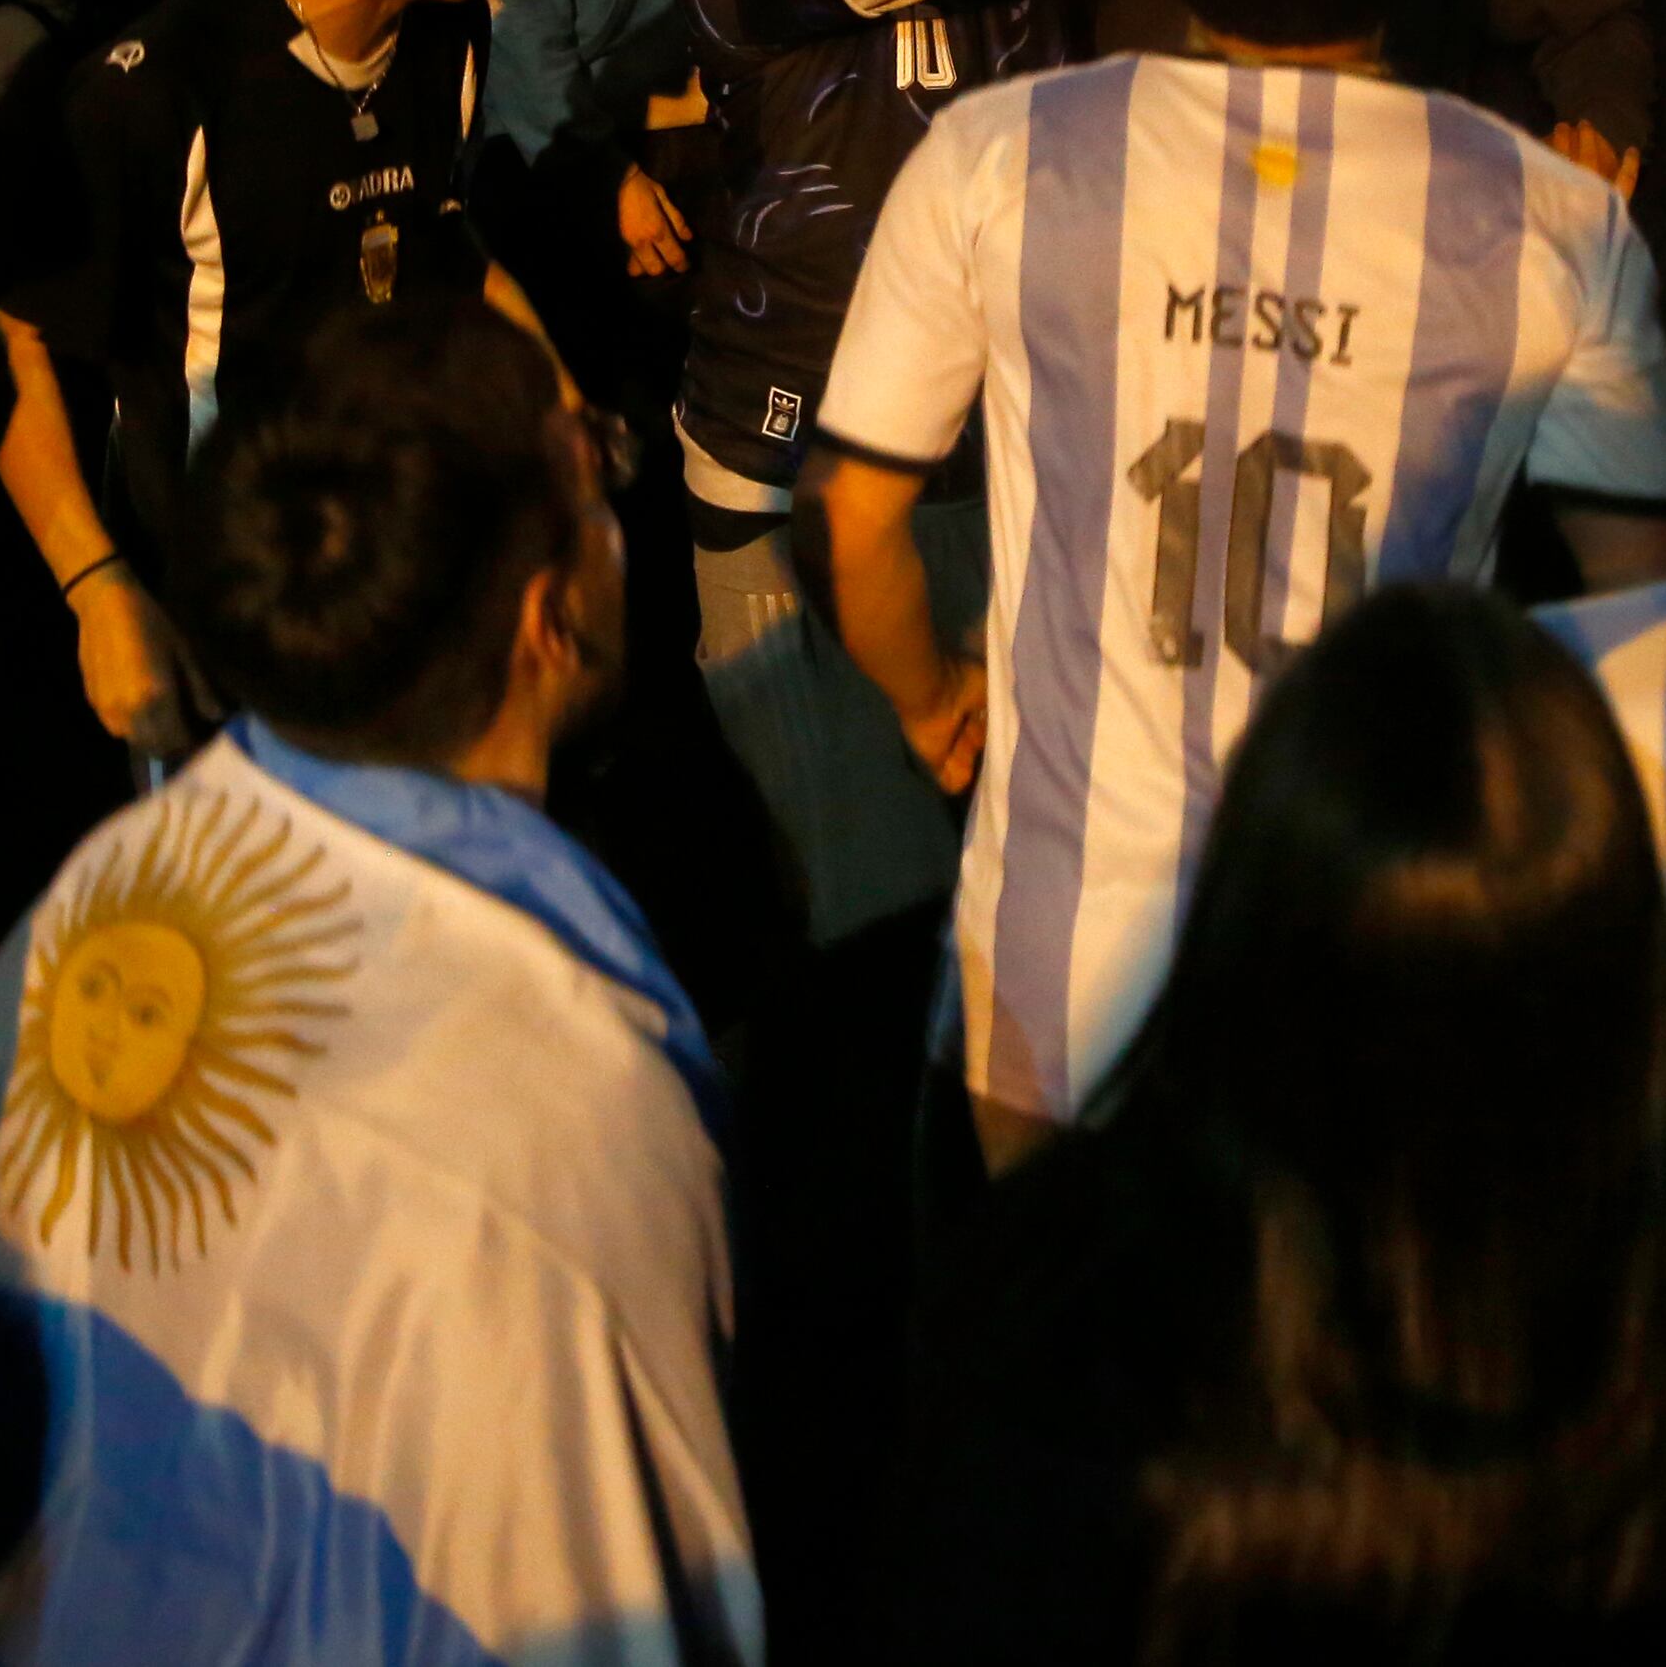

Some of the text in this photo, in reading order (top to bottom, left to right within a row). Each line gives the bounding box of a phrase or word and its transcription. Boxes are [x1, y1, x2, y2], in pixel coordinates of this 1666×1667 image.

[350, 163, 415, 204] ADRA
[1165, 283, 1360, 367] MESSI
[1128, 416, 1373, 679] 10
